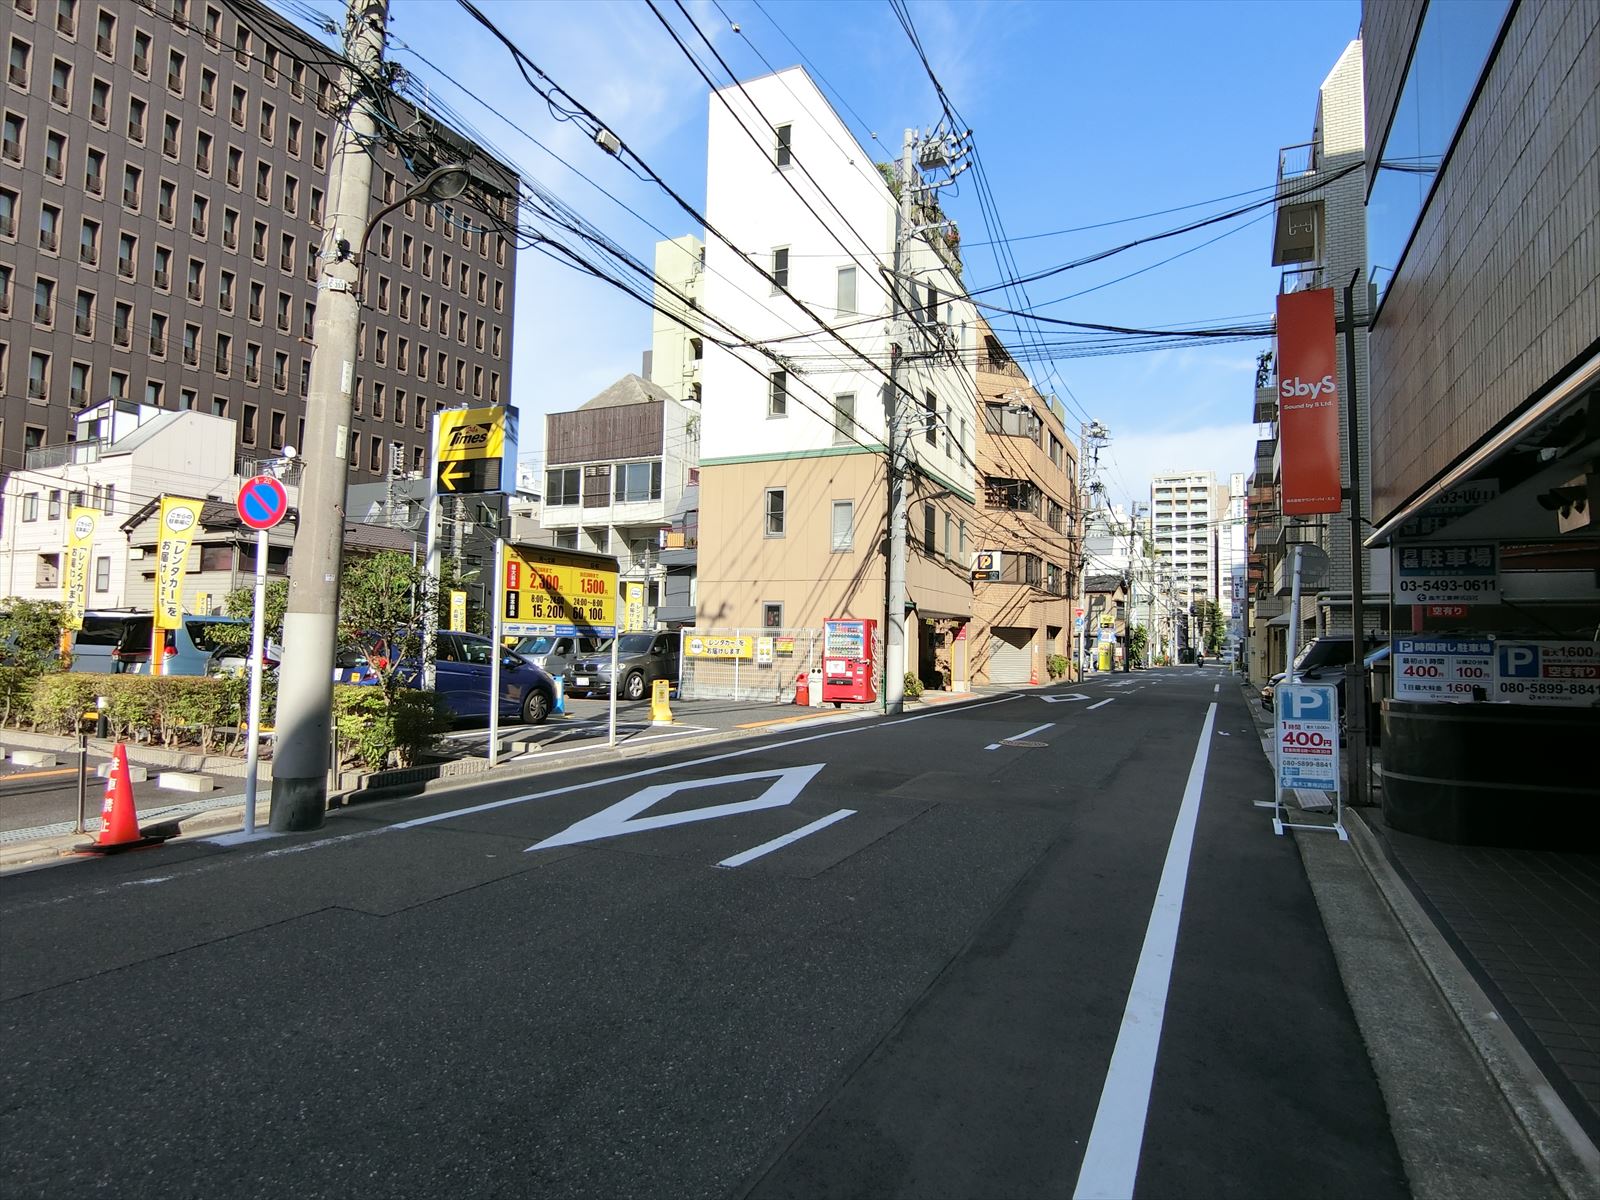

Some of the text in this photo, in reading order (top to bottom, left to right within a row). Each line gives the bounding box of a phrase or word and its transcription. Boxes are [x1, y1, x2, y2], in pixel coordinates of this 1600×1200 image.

[1281, 375, 1335, 400] SbyS
[449, 428, 489, 447] Times
[1400, 579, 1496, 592] 03-5493-0611
[1402, 642, 1411, 650] P
[1414, 642, 1491, 653] 時間貸し駐車場
[1507, 647, 1533, 675] P
[1292, 690, 1322, 718] P
[1282, 731, 1332, 747] 400円
[1283, 760, 1332, 769] 080-5899-8841
